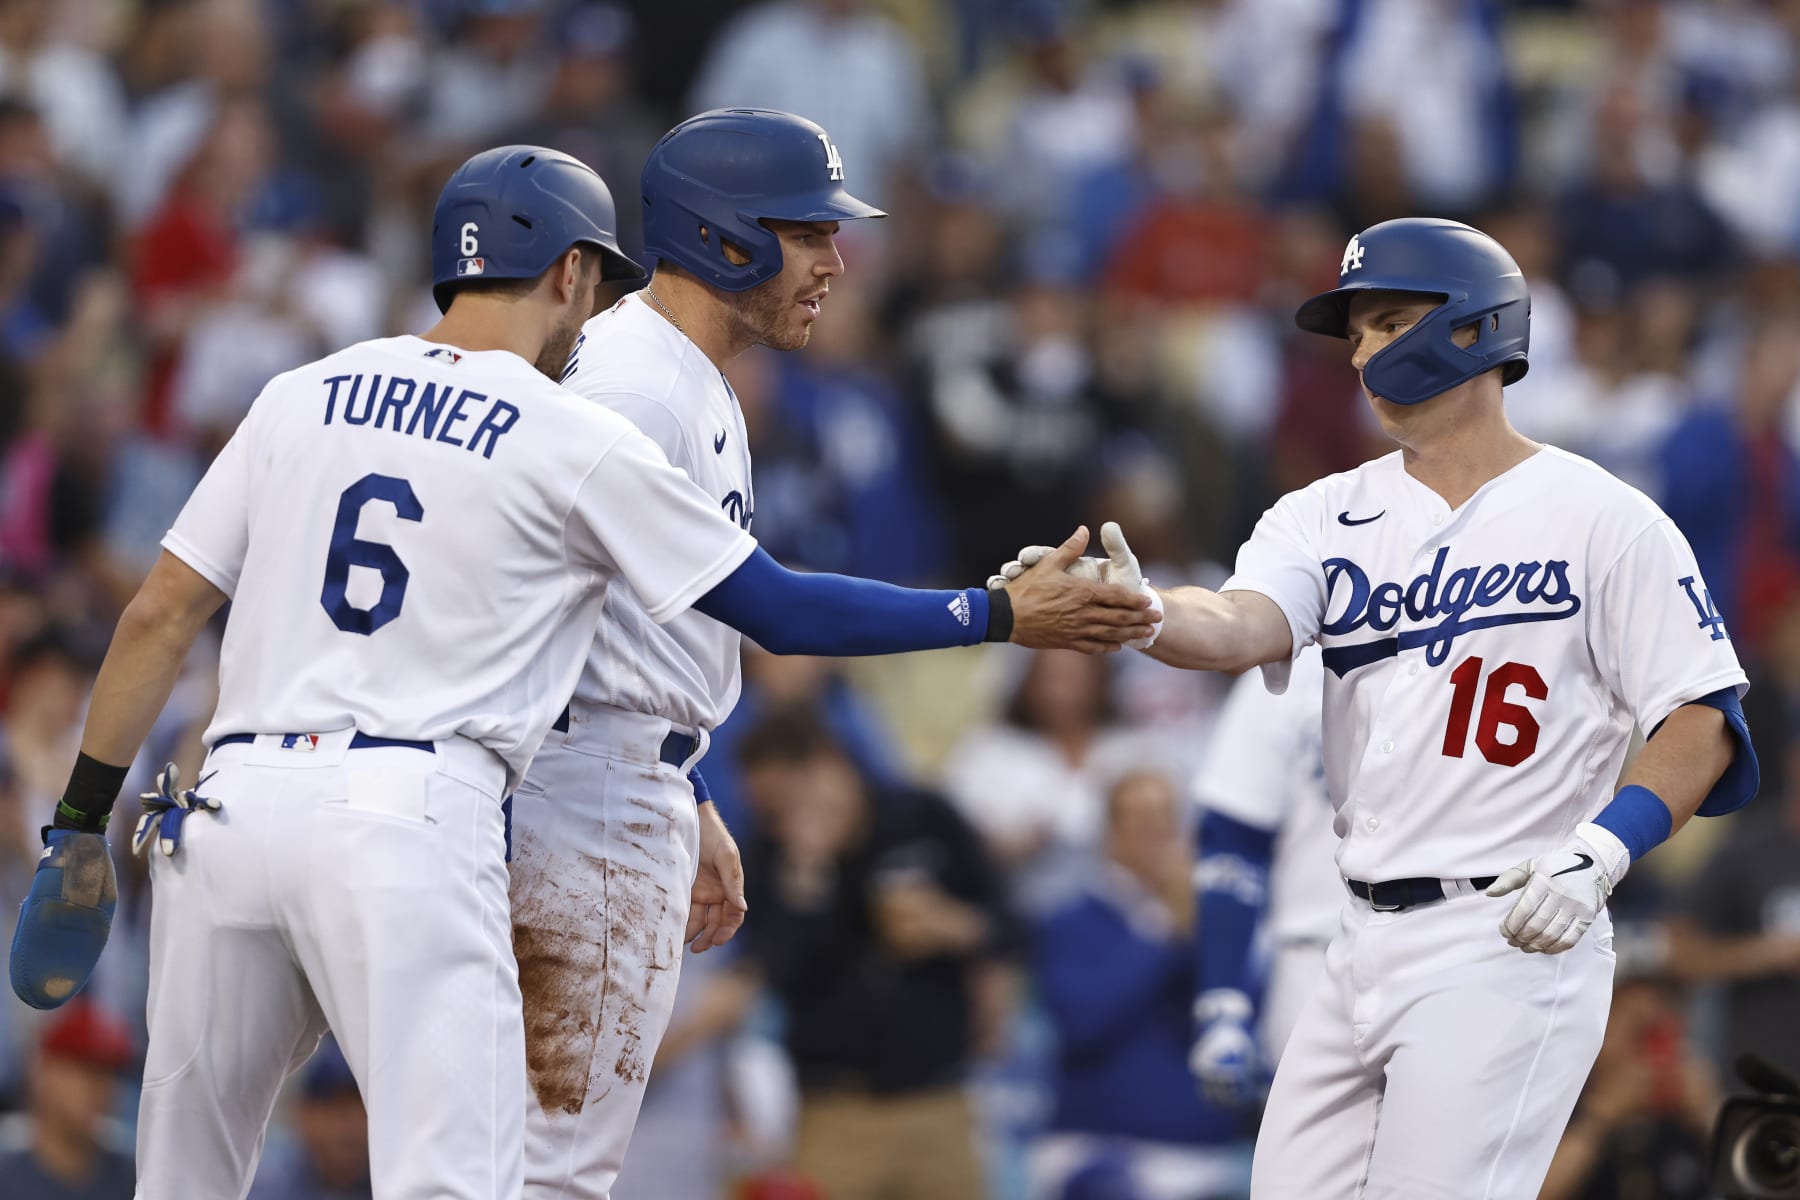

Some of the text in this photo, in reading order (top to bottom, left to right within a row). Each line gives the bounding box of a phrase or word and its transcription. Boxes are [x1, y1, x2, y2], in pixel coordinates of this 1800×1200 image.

[461, 222, 479, 257] 6
[323, 374, 520, 460] TURNER
[320, 472, 424, 636] 6
[958, 591, 970, 626] adidas
[1321, 546, 1581, 667] Dodgers
[1441, 655, 1549, 768] 16
